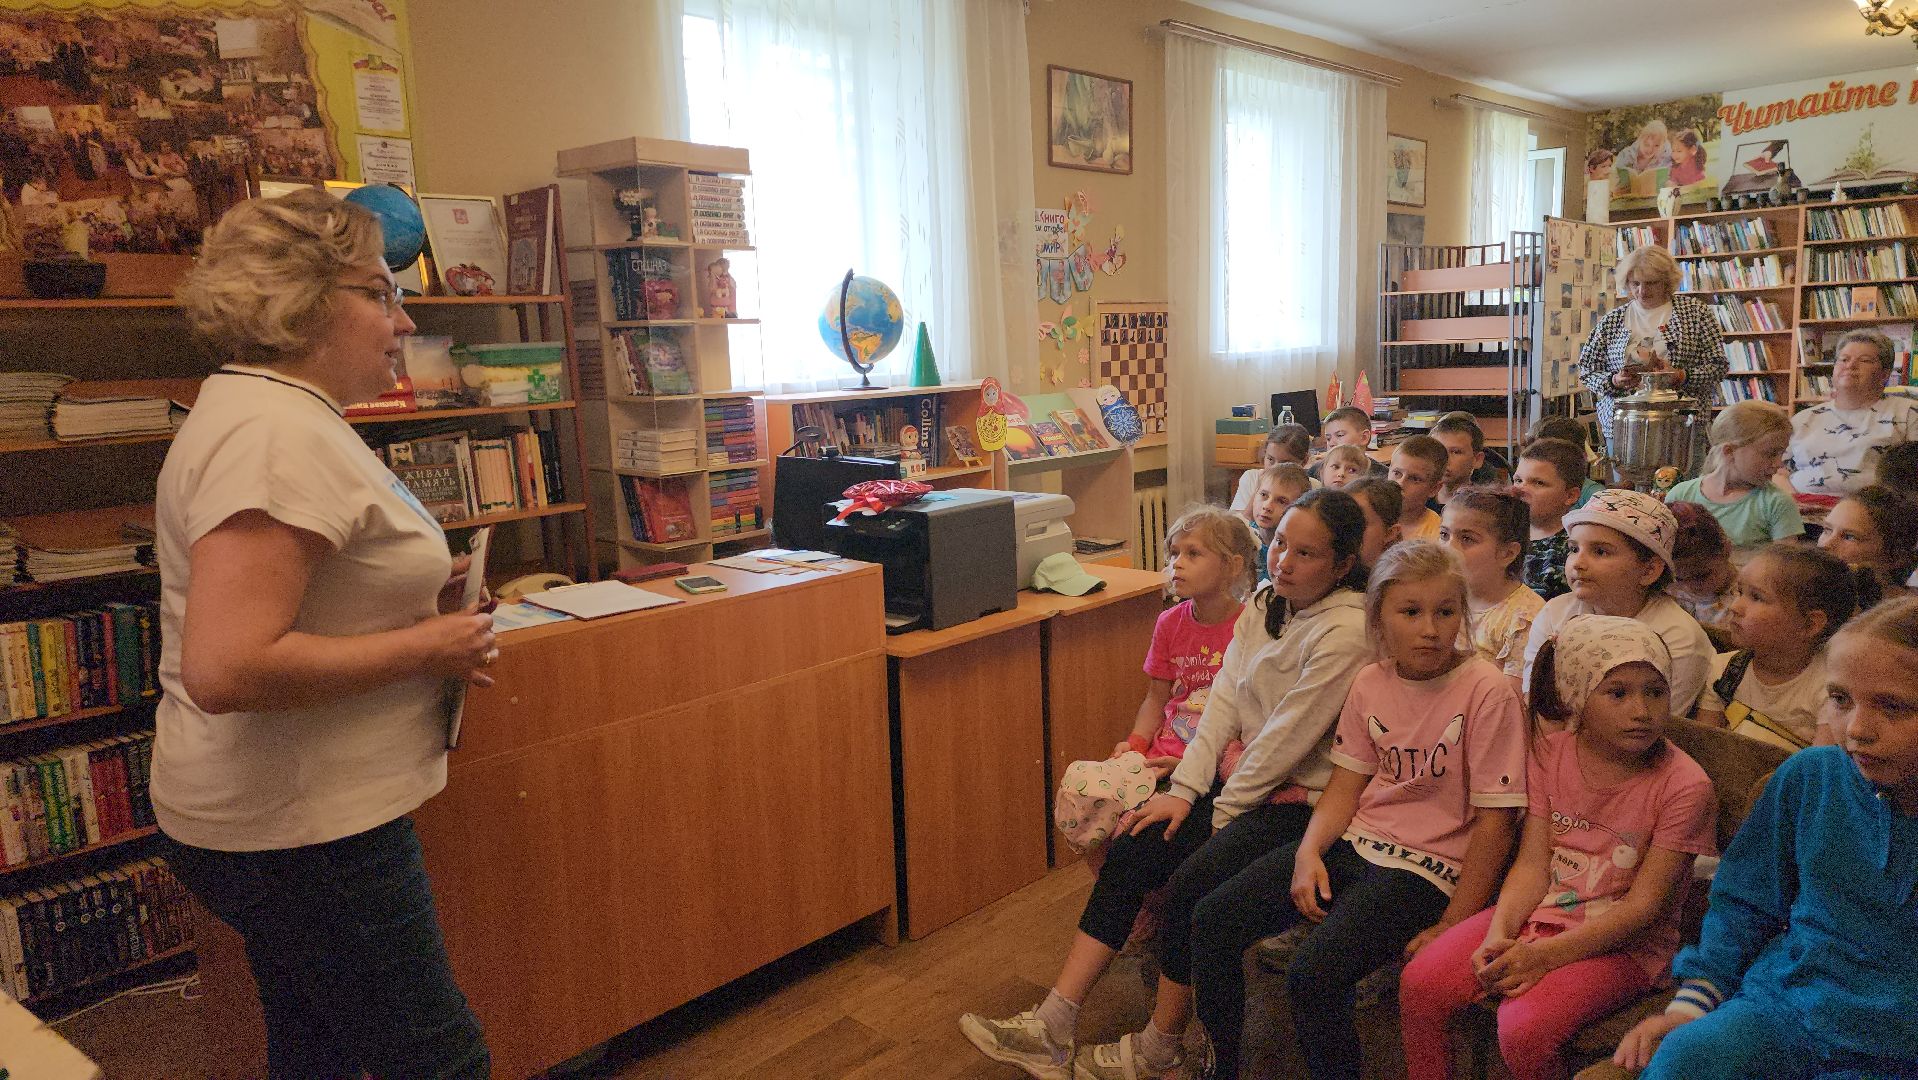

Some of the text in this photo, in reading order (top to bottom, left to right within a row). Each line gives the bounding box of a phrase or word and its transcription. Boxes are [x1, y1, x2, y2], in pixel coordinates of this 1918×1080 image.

[1716, 80, 1899, 136] Читайте
[921, 399, 932, 448] Collins
[405, 468, 450, 480] ЖИВАЯ
